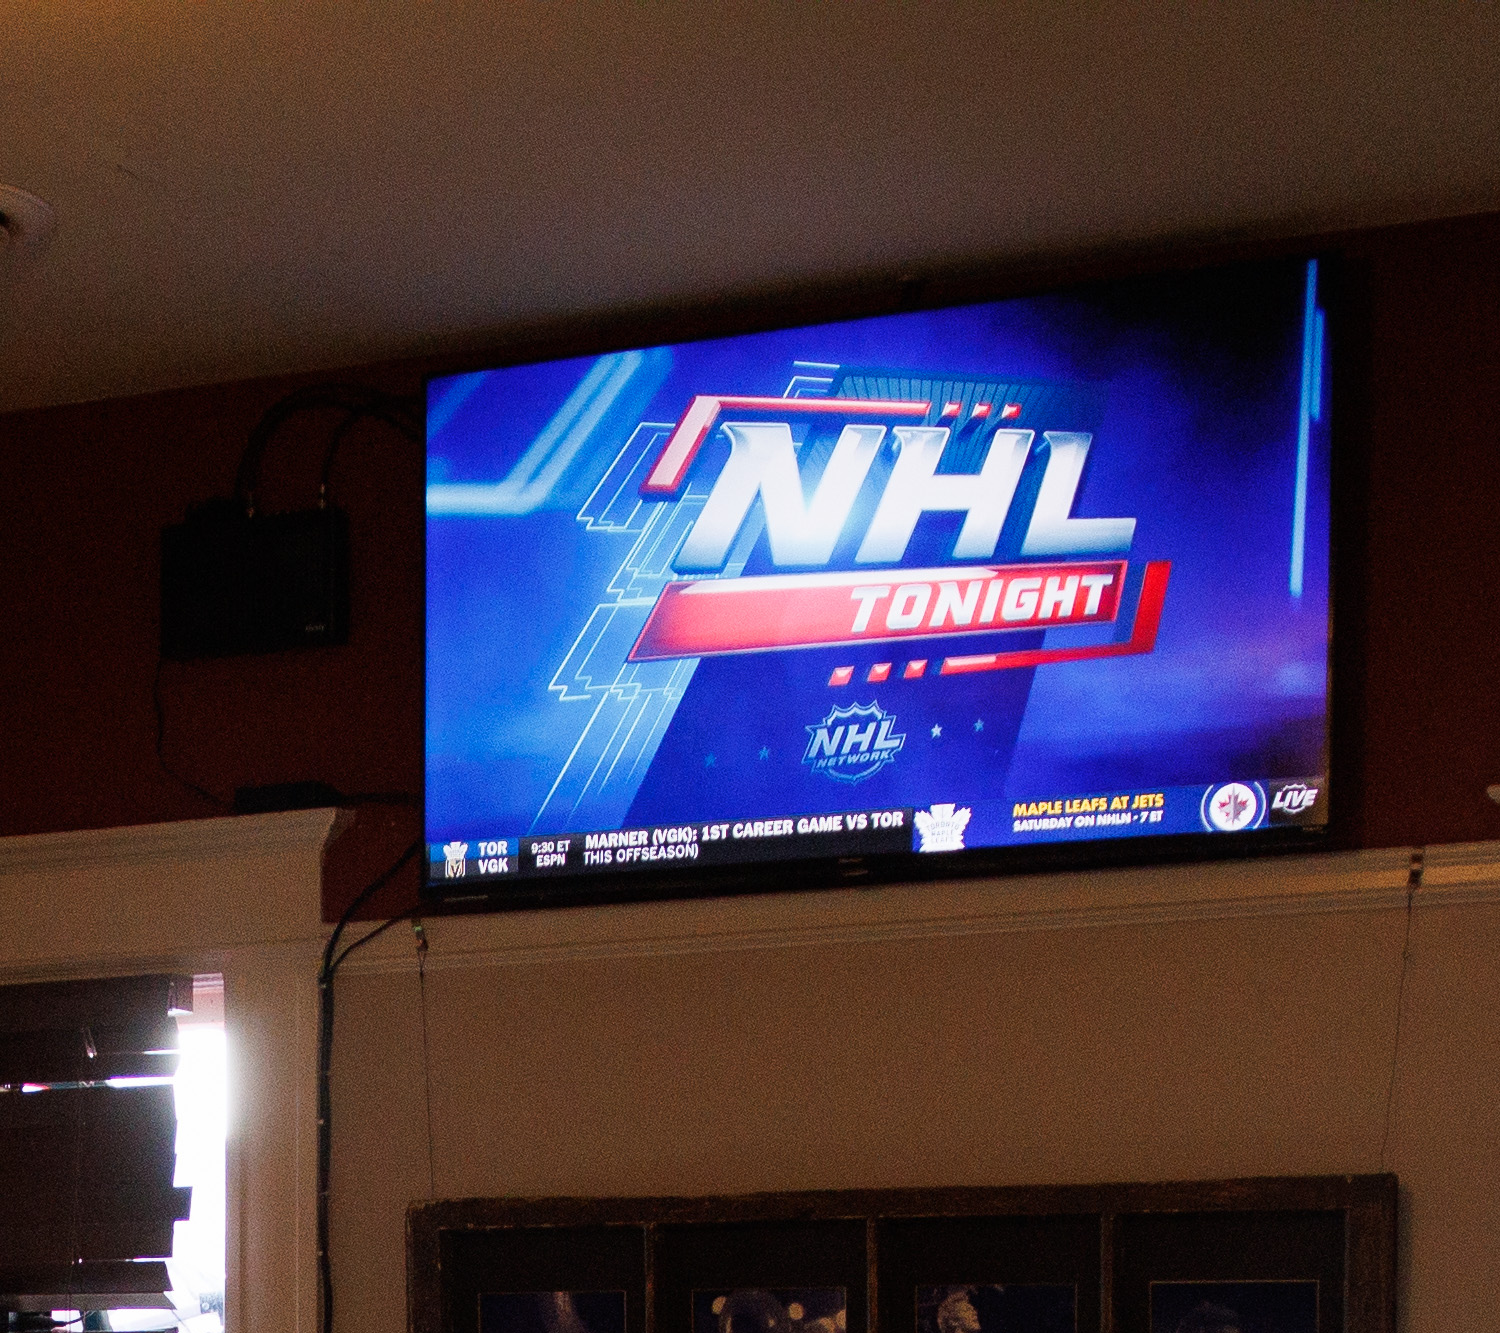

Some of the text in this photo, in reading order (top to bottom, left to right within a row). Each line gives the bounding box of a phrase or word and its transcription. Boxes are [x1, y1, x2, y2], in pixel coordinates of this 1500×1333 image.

[671, 422, 1136, 571] NHL
[850, 574, 1114, 633] TONIGHT
[807, 720, 901, 758] NHL
[816, 750, 891, 769] NETWORK
[1013, 794, 1164, 818] MAPLE LEAFS AT JETS
[1271, 789, 1318, 809] LIVE
[585, 830, 648, 849] MARNER
[702, 823, 730, 842] 1ST
[732, 819, 794, 838] CAREER
[796, 815, 843, 834] GAME
[846, 813, 868, 831] VS
[870, 811, 904, 829] TOR
[1013, 810, 1164, 833] SATURDAY ON NHLN 7 ET
[478, 840, 508, 857] TOR
[531, 840, 571, 855] 9:30 ET
[584, 843, 699, 866] THIS OFFSEASON)
[478, 857, 509, 874] VGK
[536, 852, 566, 868] ESPN
